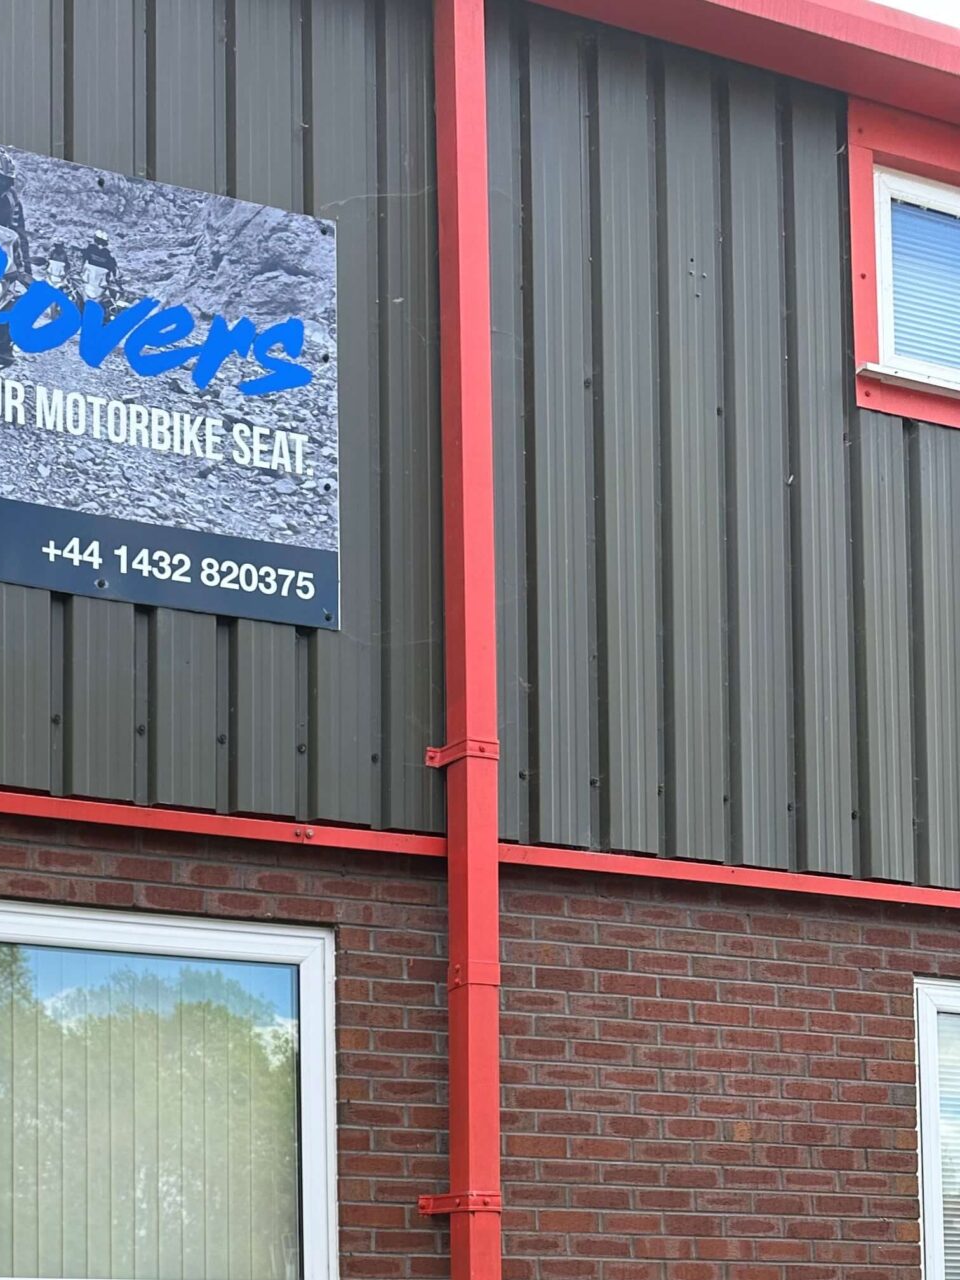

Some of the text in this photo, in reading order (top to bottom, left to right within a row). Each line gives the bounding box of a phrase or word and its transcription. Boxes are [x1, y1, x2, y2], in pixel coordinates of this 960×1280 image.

[36, 386, 223, 461] MOTORBIKE
[232, 427, 314, 476] SEAT.
[42, 537, 315, 600] +44 1432 820375
